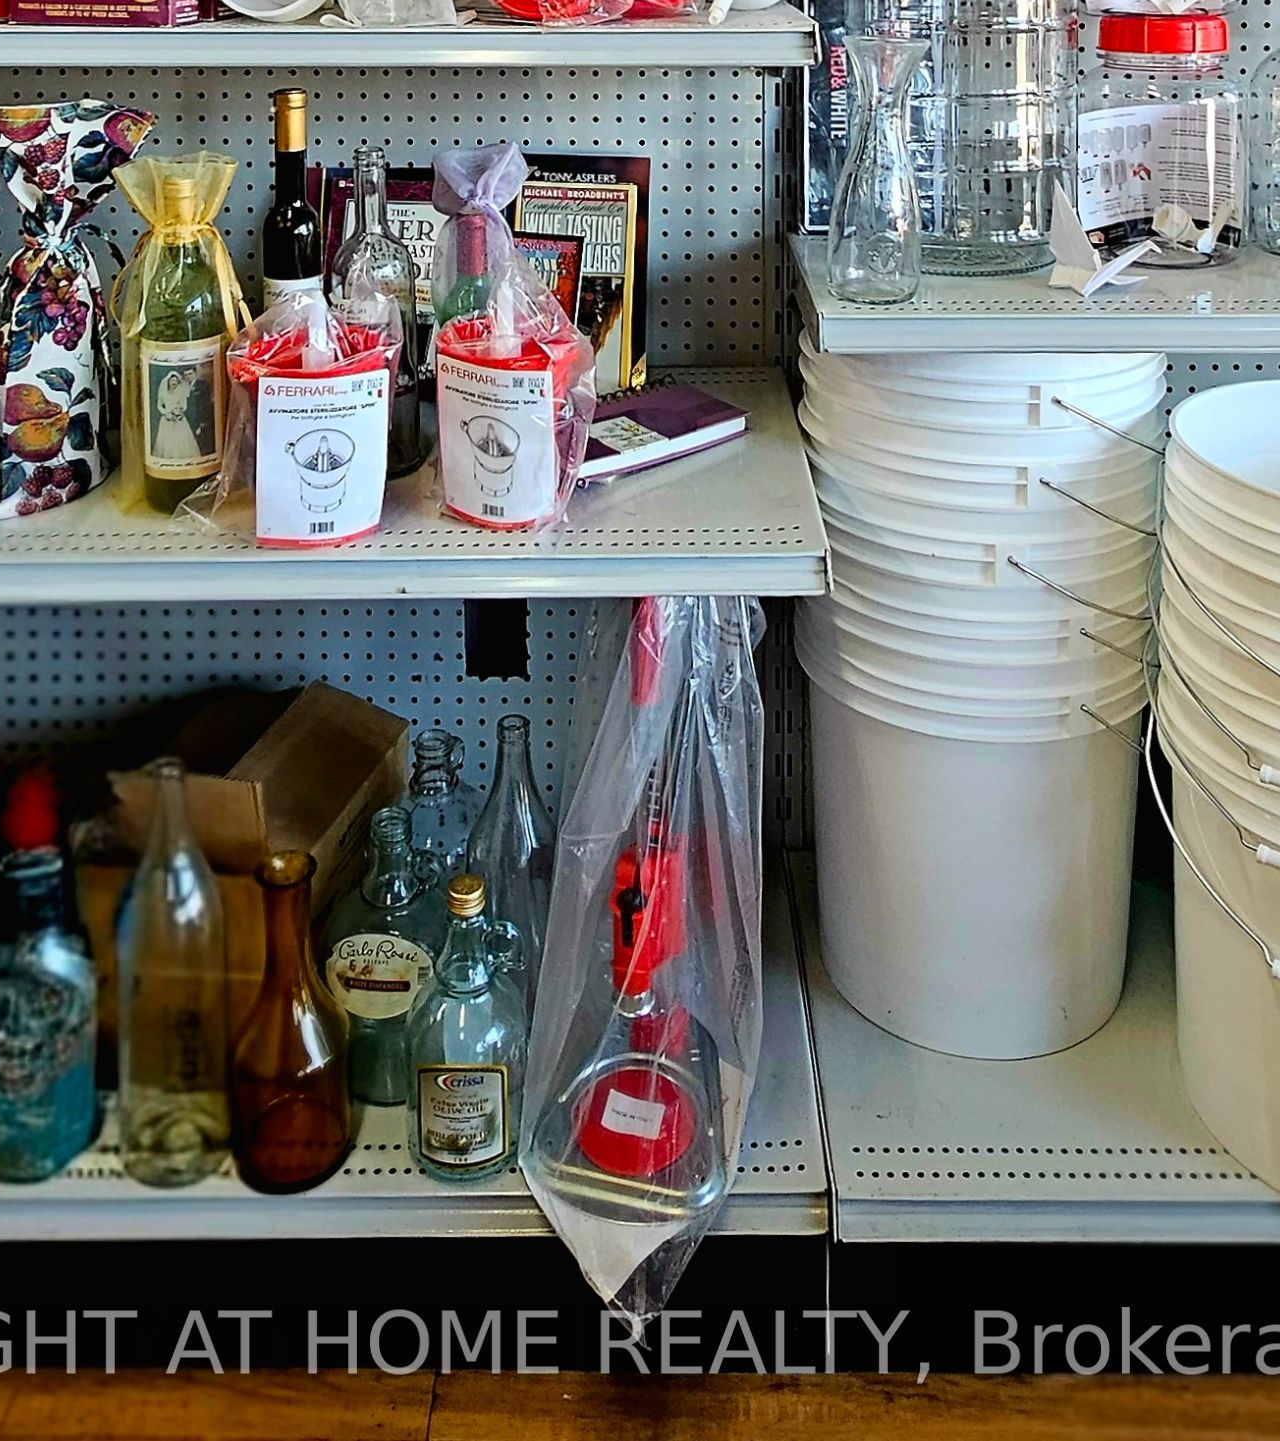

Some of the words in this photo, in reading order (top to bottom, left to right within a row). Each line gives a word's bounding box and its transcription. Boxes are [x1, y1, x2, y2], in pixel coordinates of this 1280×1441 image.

[830, 91, 849, 140] WHITE
[542, 172, 573, 182] TONY
[575, 173, 617, 184] ASPLER'S
[524, 188, 563, 198] MICHAEL
[567, 191, 625, 200] BROADBENT'S
[391, 209, 410, 217] THE
[524, 199, 569, 214] Complete
[570, 202, 604, 213] Guide
[524, 212, 561, 236] WINE
[565, 214, 623, 244] TASTING
[582, 244, 622, 274] LLARS
[450, 366, 497, 387] FERRARI
[277, 385, 335, 397] FERRARI
[338, 939, 374, 961] Carlo
[376, 939, 419, 962] Rossi
[349, 980, 368, 988] WHITE
[449, 1074, 485, 1088] crissa
[432, 1105, 465, 1114] OLIVE
[467, 1105, 487, 1114] OIL
